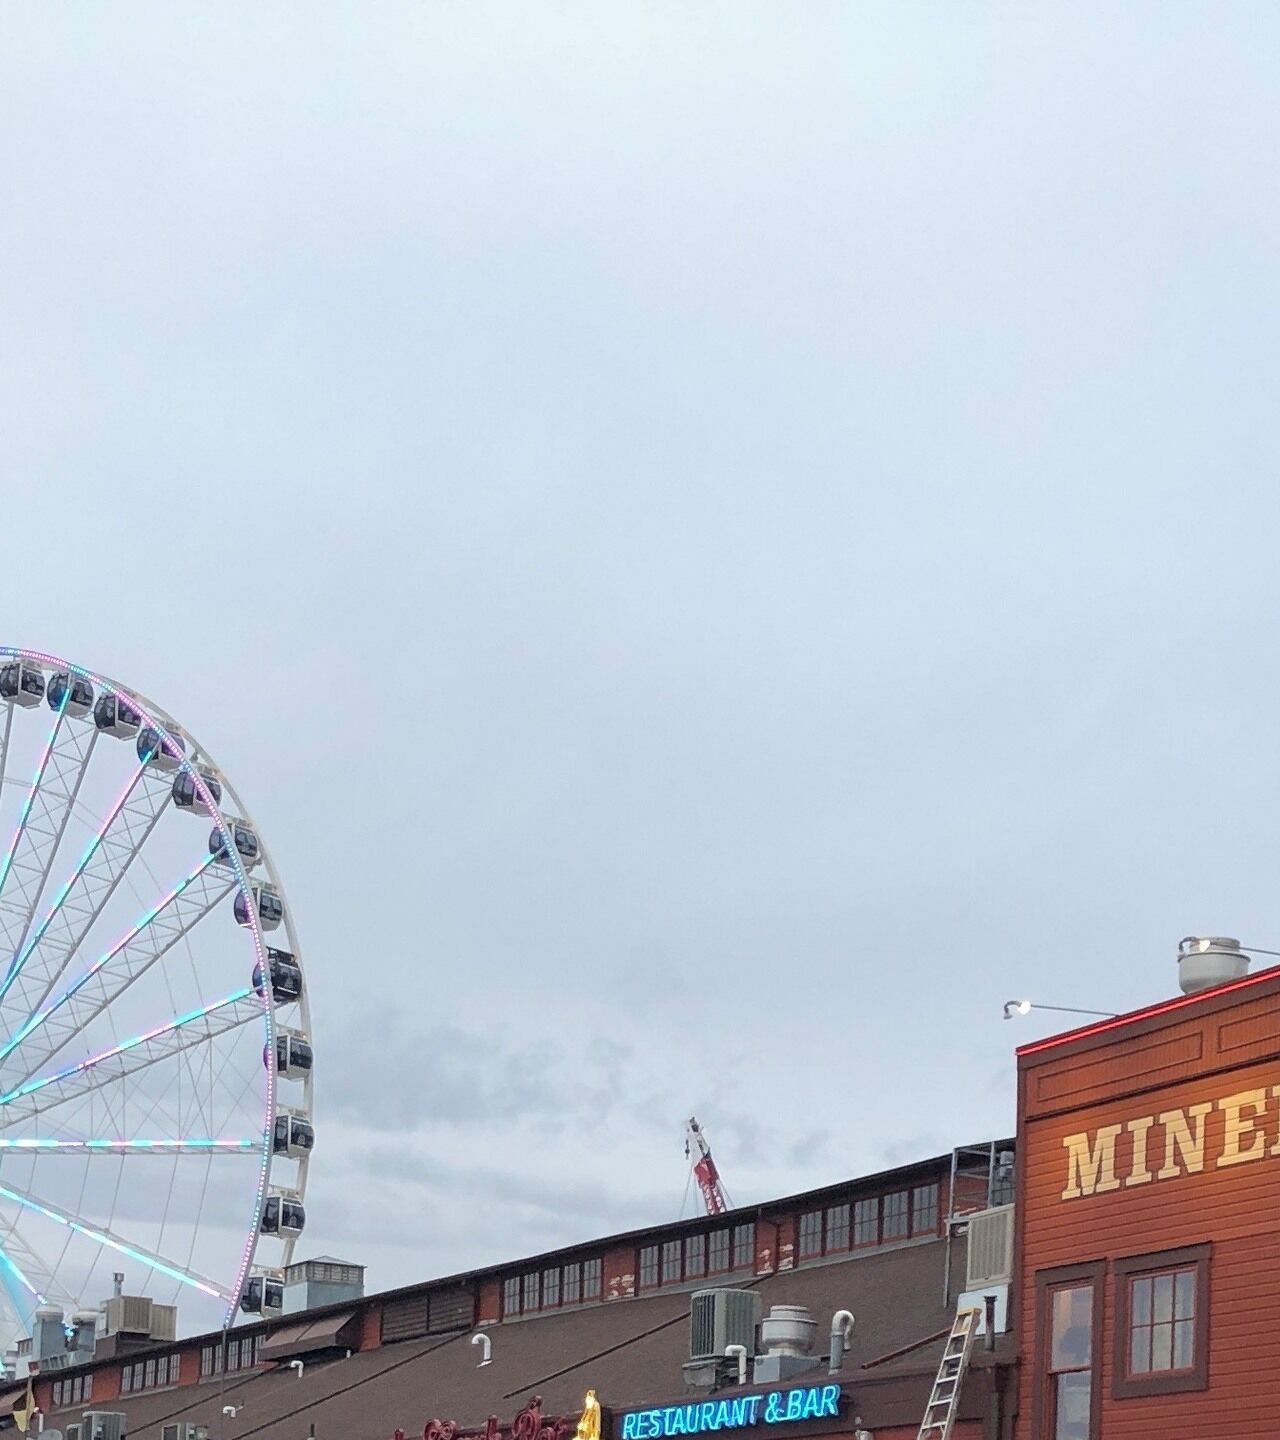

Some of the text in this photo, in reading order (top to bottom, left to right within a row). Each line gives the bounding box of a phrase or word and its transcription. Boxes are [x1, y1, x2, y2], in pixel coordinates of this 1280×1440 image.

[623, 1384, 842, 1440] RESTAURANT & BAR
